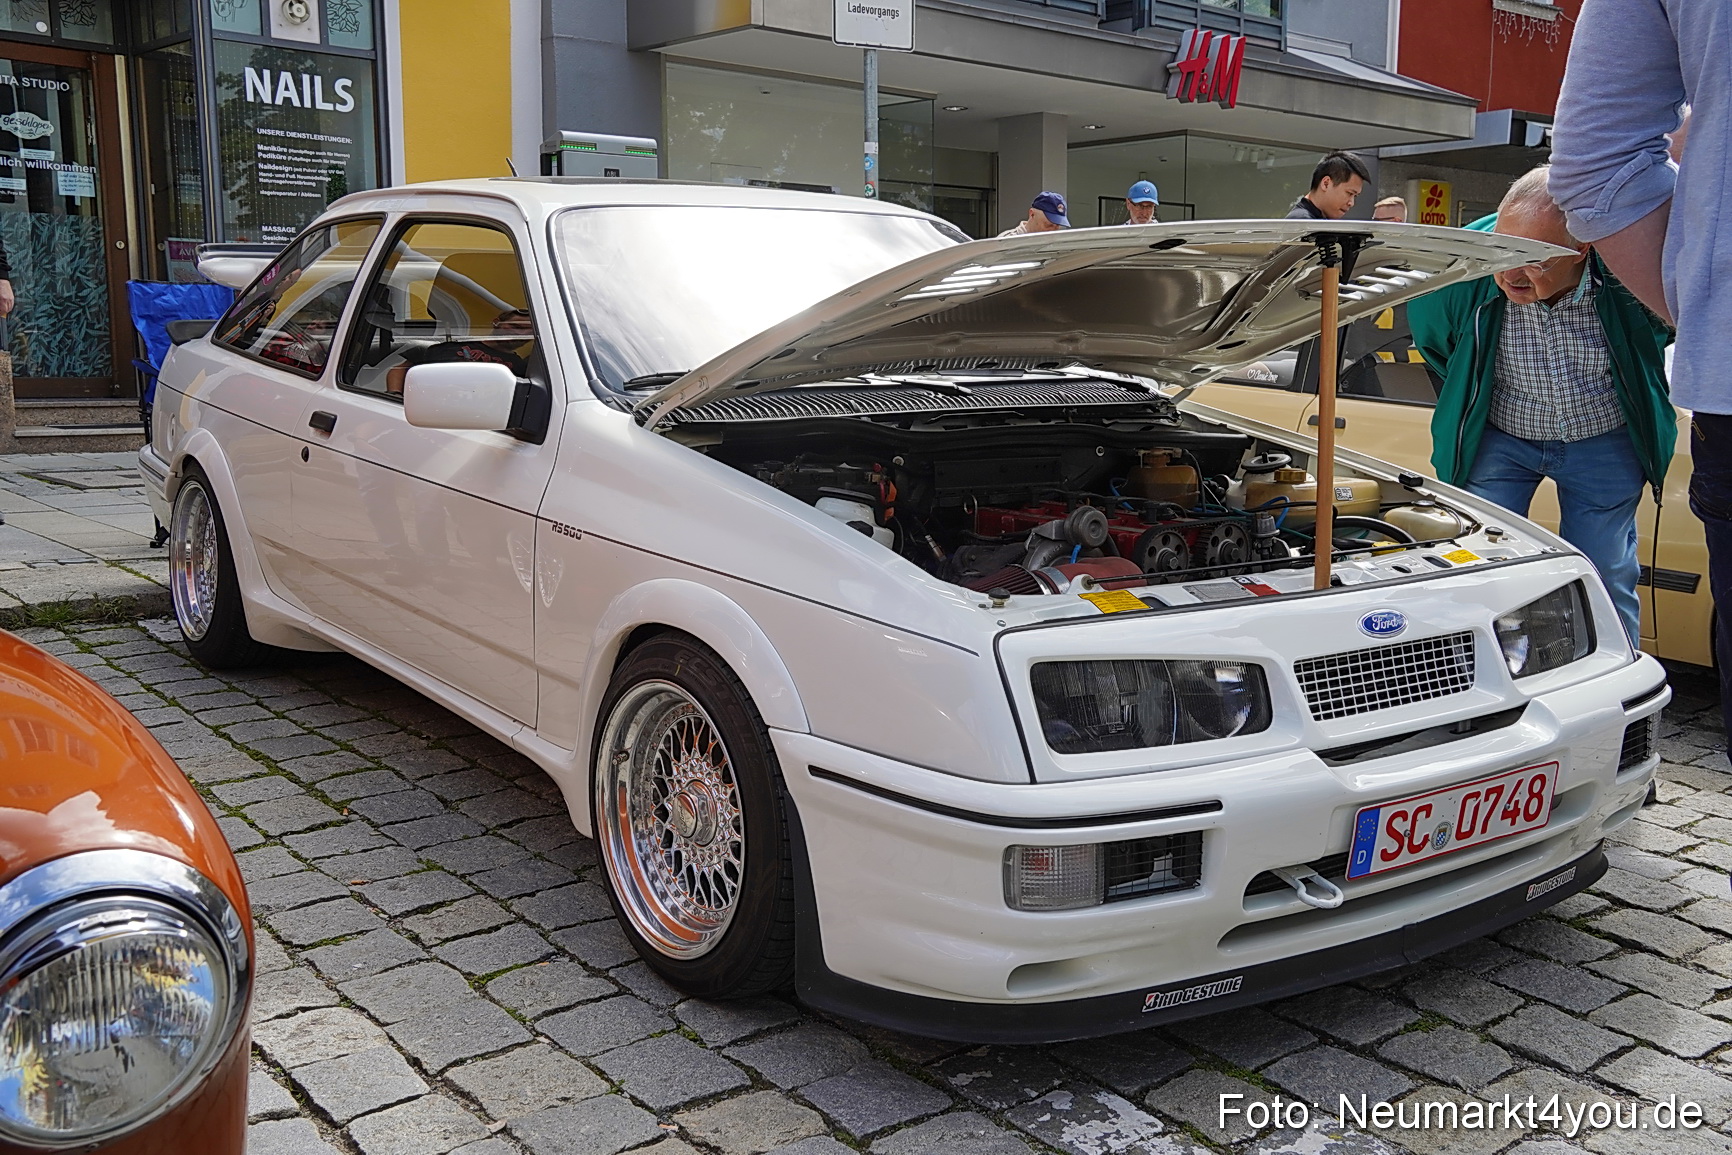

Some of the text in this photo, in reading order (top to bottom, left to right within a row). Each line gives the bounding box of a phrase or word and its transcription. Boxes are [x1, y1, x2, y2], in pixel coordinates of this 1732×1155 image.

[847, 2, 900, 20] Ladevorgangs
[1170, 29, 1246, 109] H&M
[21, 77, 70, 91] STUDIO
[245, 66, 355, 113] NAILS
[257, 128, 352, 143] UNSERE DIENSTLEISTUNGEN:
[258, 144, 287, 152] Maniküre
[258, 152, 286, 160] Pediküre
[26, 160, 96, 174] willkommen
[259, 163, 292, 172] Naildesign
[1421, 212, 1446, 225] LOTTO
[552, 521, 582, 541] RS500
[1372, 614, 1399, 631] Ford
[1380, 803, 1433, 862] SC
[1454, 773, 1547, 842] 0748
[1356, 850, 1367, 865] D
[1527, 867, 1576, 900] BRIDGESTONE
[1143, 977, 1242, 1011] BRIDGESTONE
